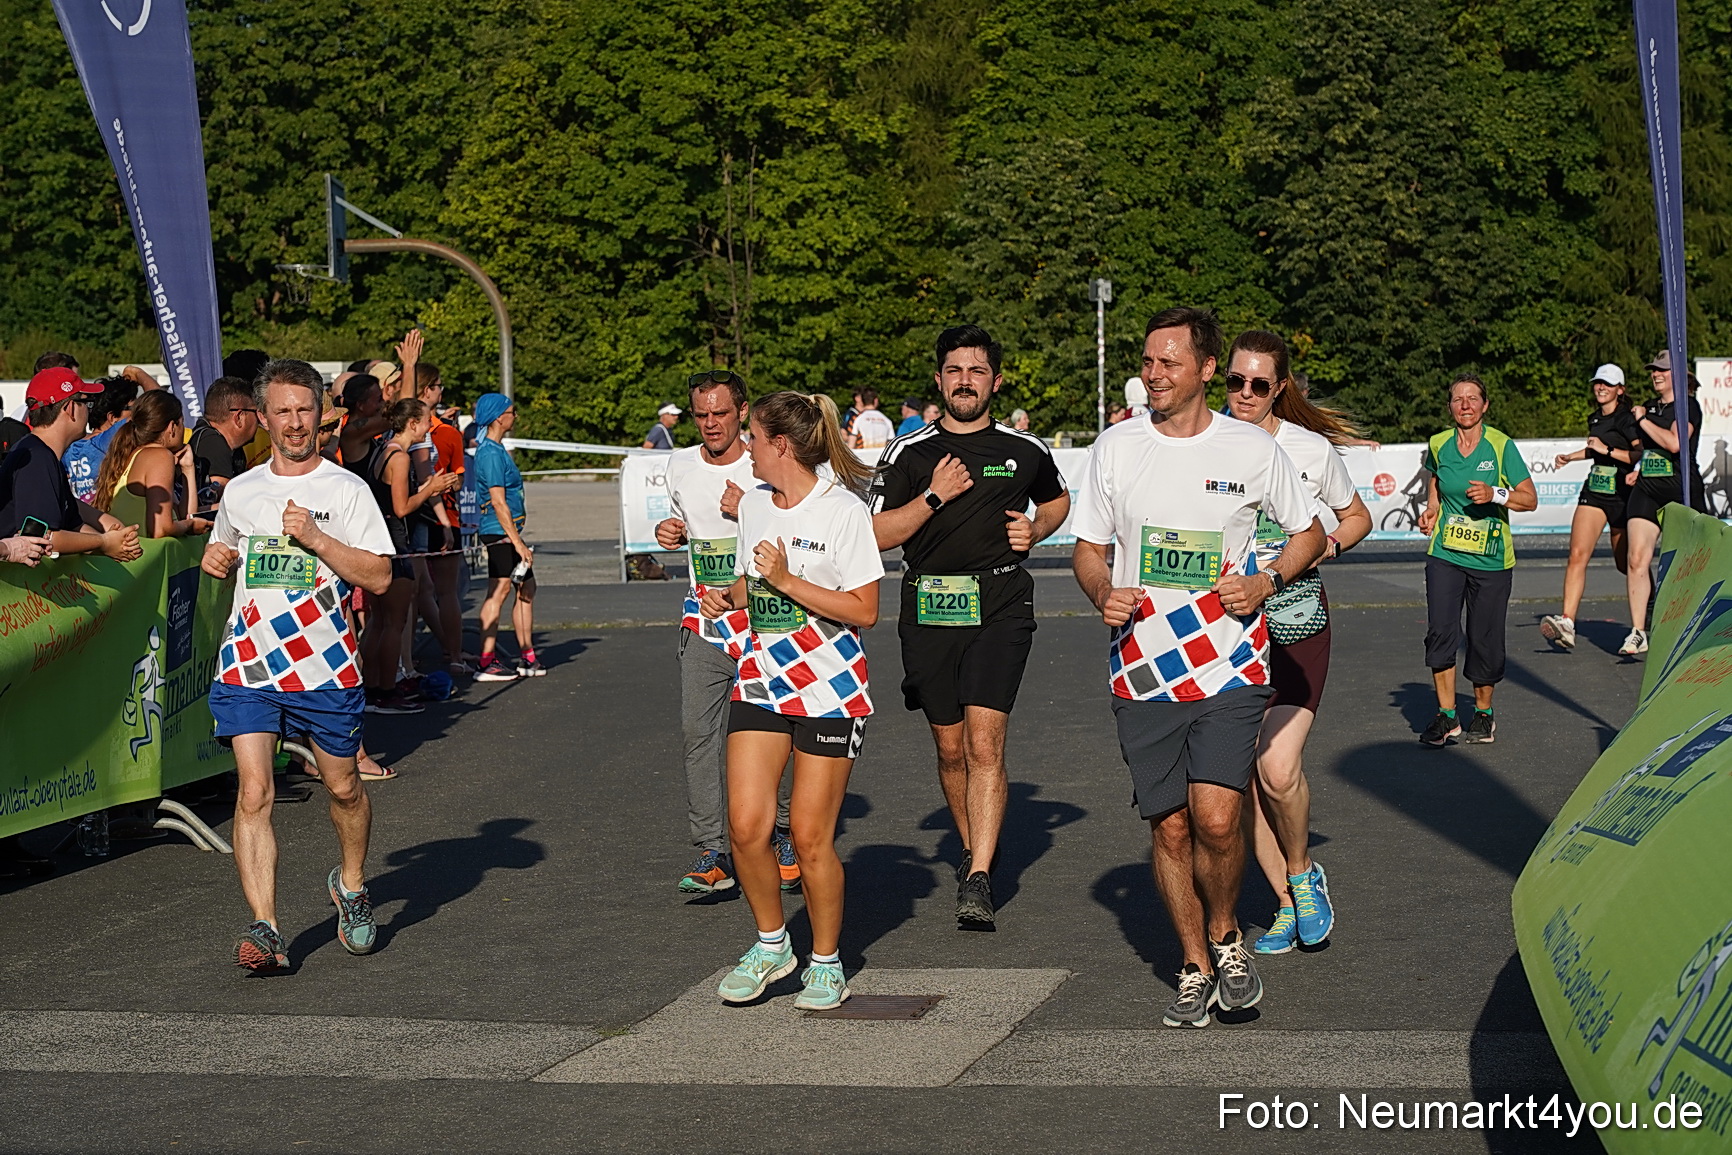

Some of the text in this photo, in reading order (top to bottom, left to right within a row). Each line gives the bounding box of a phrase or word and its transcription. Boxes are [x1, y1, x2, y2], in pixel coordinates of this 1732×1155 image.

[1477, 460, 1495, 469] AOK
[1645, 458, 1667, 468] 1055
[645, 474, 667, 488] NO
[983, 470, 1015, 478] neumarkt
[1591, 475, 1610, 484] 1054
[1450, 526, 1480, 542] 1985
[258, 554, 304, 573] 1073
[700, 554, 736, 570] 1070
[1144, 553, 1153, 573] RUN
[1155, 548, 1206, 571] 1071
[305, 558, 314, 583] 2022
[1151, 568, 1209, 579] Seeberger Andreas
[1209, 555, 1218, 583] 2022
[751, 595, 793, 615] 1065
[926, 593, 968, 609] 1220
[816, 733, 848, 744] hummel
